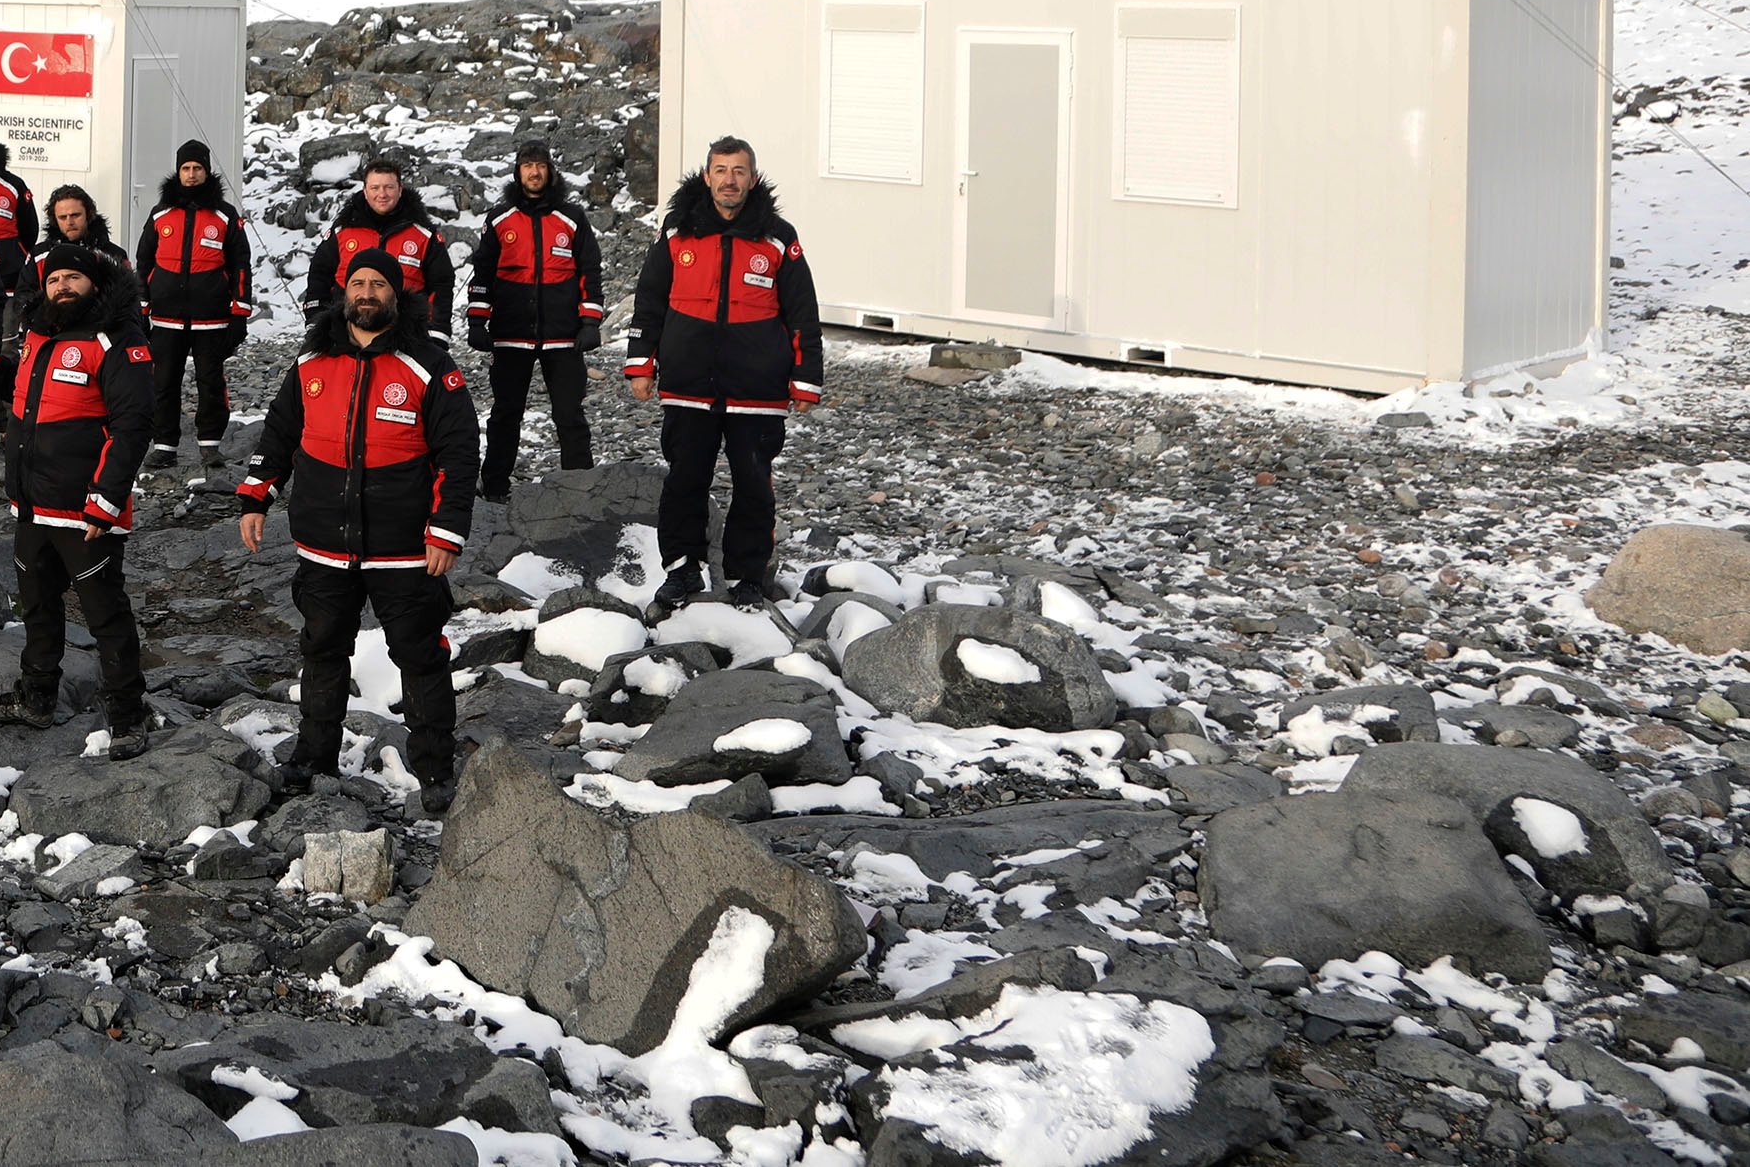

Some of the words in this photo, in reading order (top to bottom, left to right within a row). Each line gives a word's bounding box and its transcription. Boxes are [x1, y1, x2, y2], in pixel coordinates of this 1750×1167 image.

[28, 117, 84, 130] SCIENTIFIC
[8, 130, 60, 142] RESEARCH
[20, 146, 45, 155] CAMP
